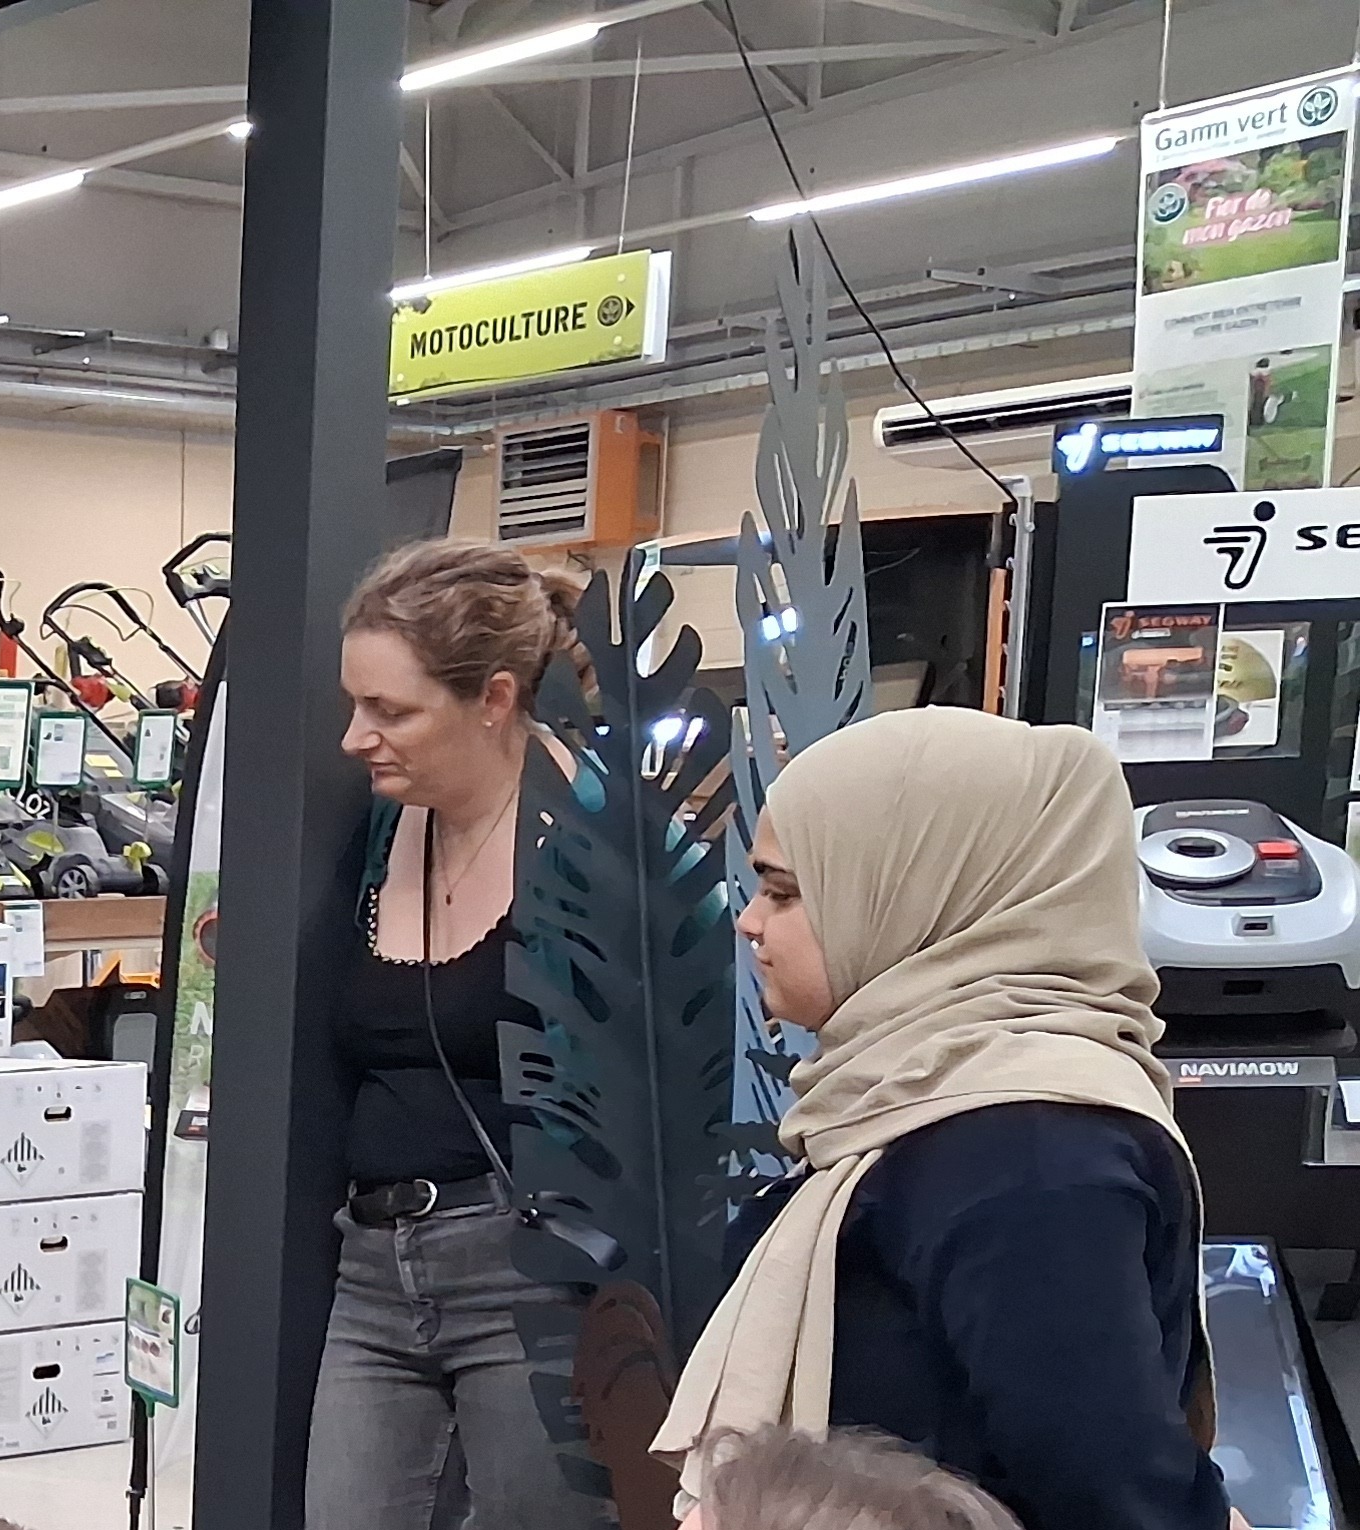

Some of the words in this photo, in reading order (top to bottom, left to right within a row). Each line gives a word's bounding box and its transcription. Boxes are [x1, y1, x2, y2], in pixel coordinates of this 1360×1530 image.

[1155, 121, 1228, 151] Gamm
[1237, 103, 1288, 132] vert
[410, 302, 588, 359] MOTOCULTURE
[1180, 1061, 1299, 1077] NAVIMOW
